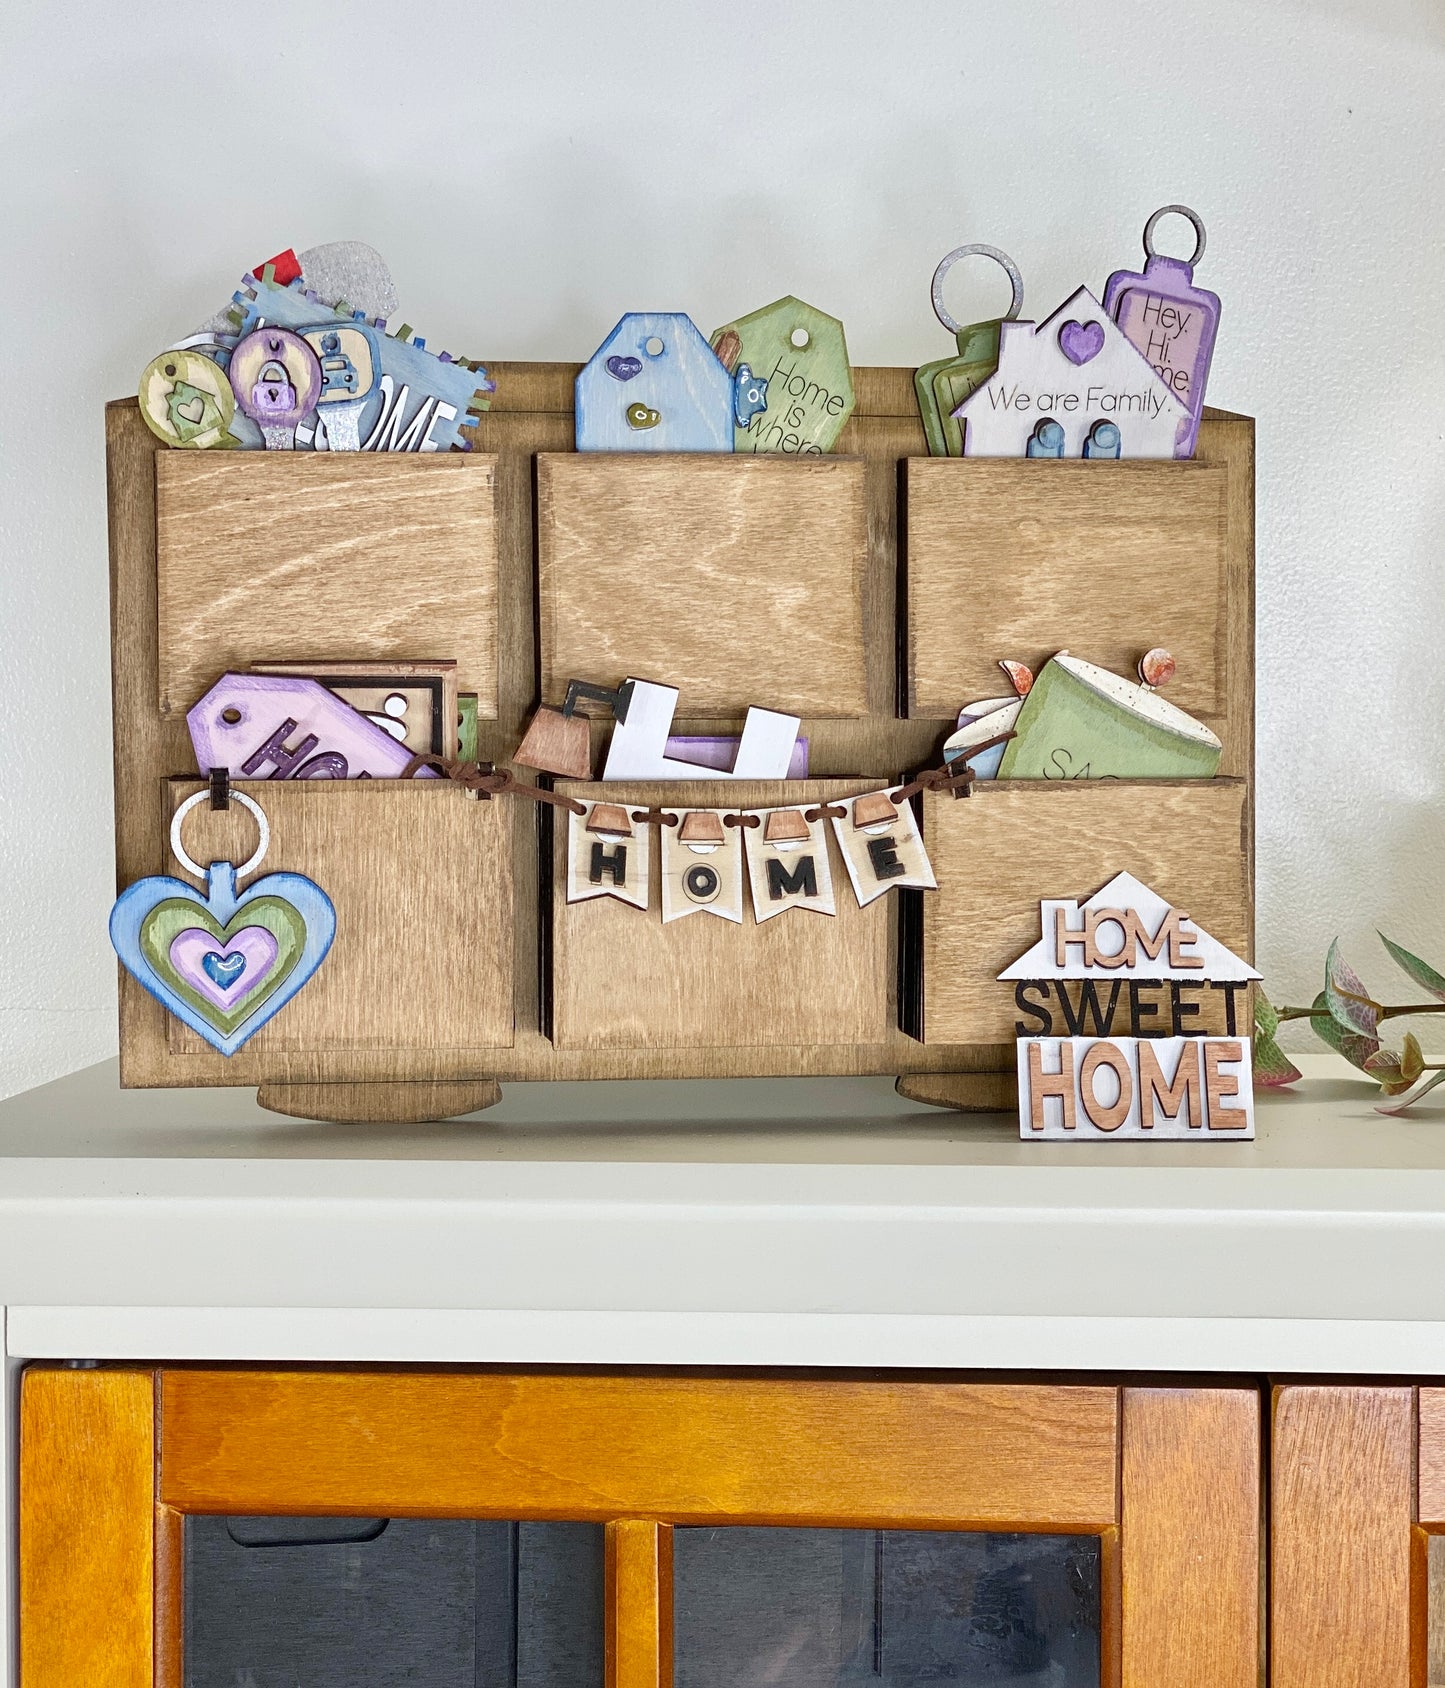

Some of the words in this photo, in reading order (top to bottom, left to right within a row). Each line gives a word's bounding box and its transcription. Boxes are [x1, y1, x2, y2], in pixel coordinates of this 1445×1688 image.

[1142, 293, 1192, 340] Hey.
[1145, 329, 1171, 363] Hi.
[767, 356, 844, 416] Home
[988, 384, 1031, 411] We
[1036, 392, 1079, 412] are
[1086, 386, 1172, 420] Family.
[783, 399, 806, 428] is
[1055, 908, 1205, 969] HOME
[1015, 978, 1248, 1037] SWEET
[1027, 1041, 1247, 1131] HOME
